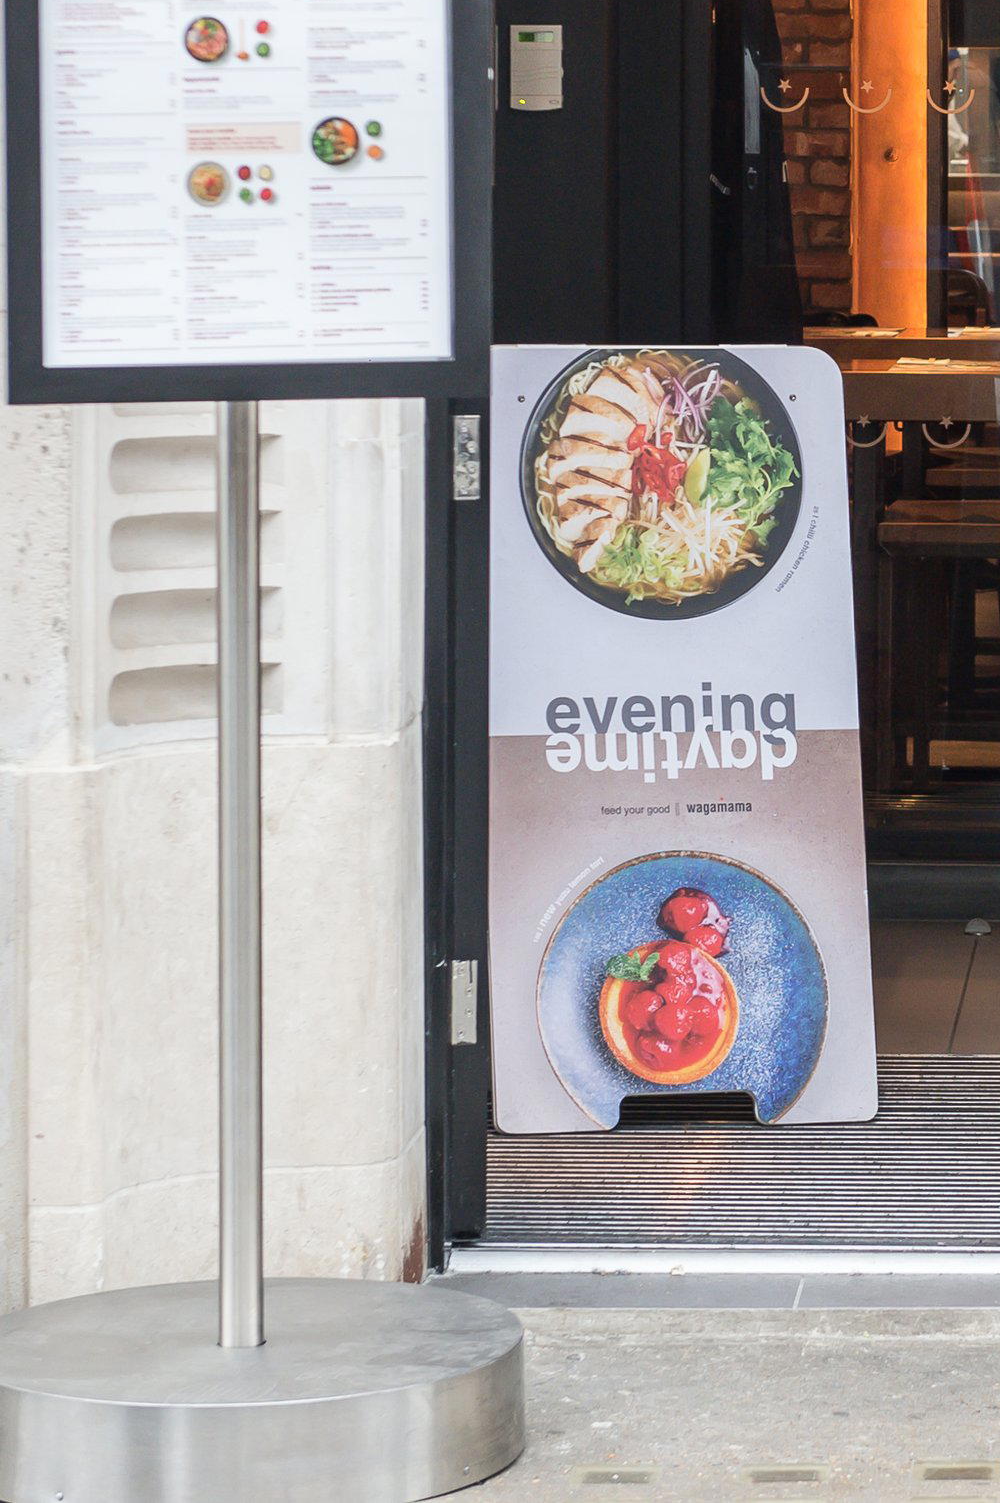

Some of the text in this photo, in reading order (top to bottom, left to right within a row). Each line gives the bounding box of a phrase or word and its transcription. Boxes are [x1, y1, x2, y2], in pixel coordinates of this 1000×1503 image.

[806, 519, 818, 540] chilli
[792, 540, 811, 570] chicken
[775, 570, 794, 593] ramen
[546, 681, 797, 745] evening
[545, 726, 798, 784] daytime
[601, 802, 752, 817] feed your good wagamama
